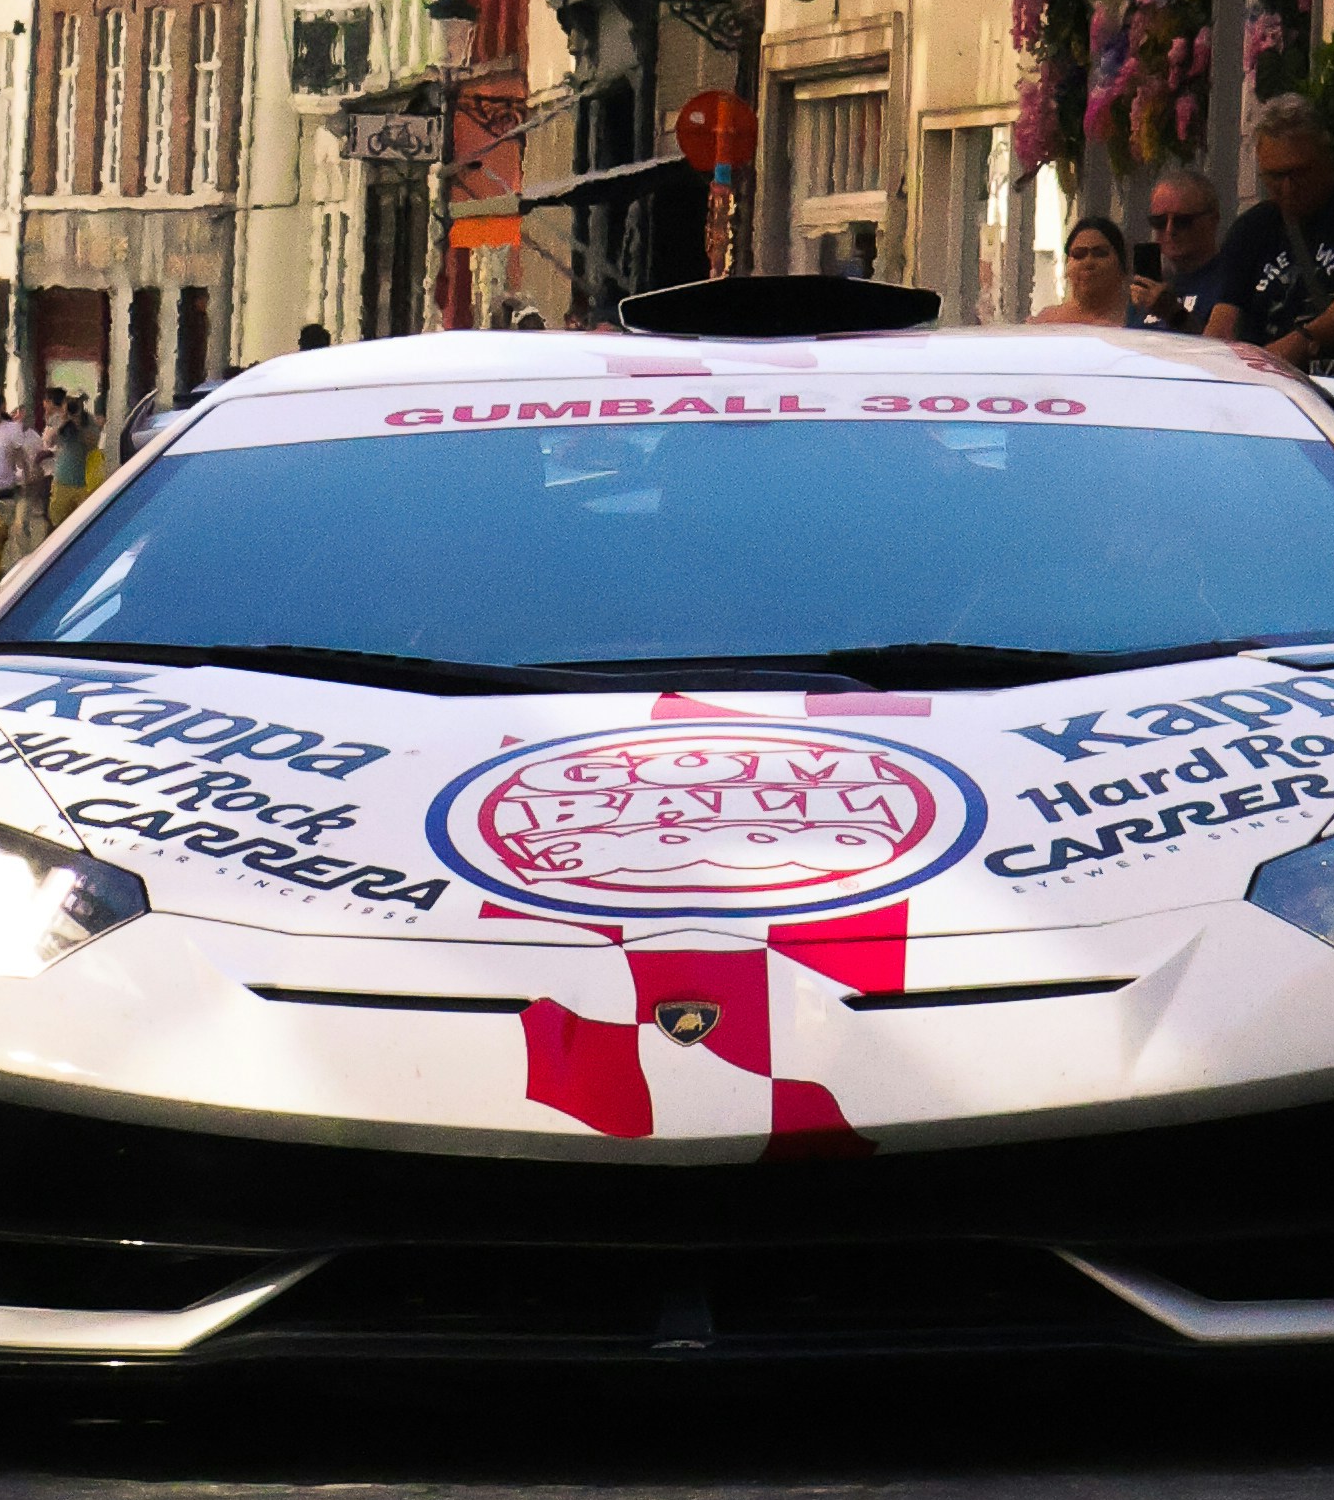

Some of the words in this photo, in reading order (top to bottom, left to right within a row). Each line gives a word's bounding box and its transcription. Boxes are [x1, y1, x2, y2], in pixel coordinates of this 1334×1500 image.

[383, 394, 826, 428] GUMBALL
[860, 394, 1087, 416] 3000
[159, 770, 362, 845] Rock
[1017, 747, 1230, 824] Hard
[58, 798, 451, 911] CARRERA
[216, 867, 317, 904] SINCE
[1012, 844, 1181, 894] EYEWEAR
[1207, 810, 1313, 841] SINCE
